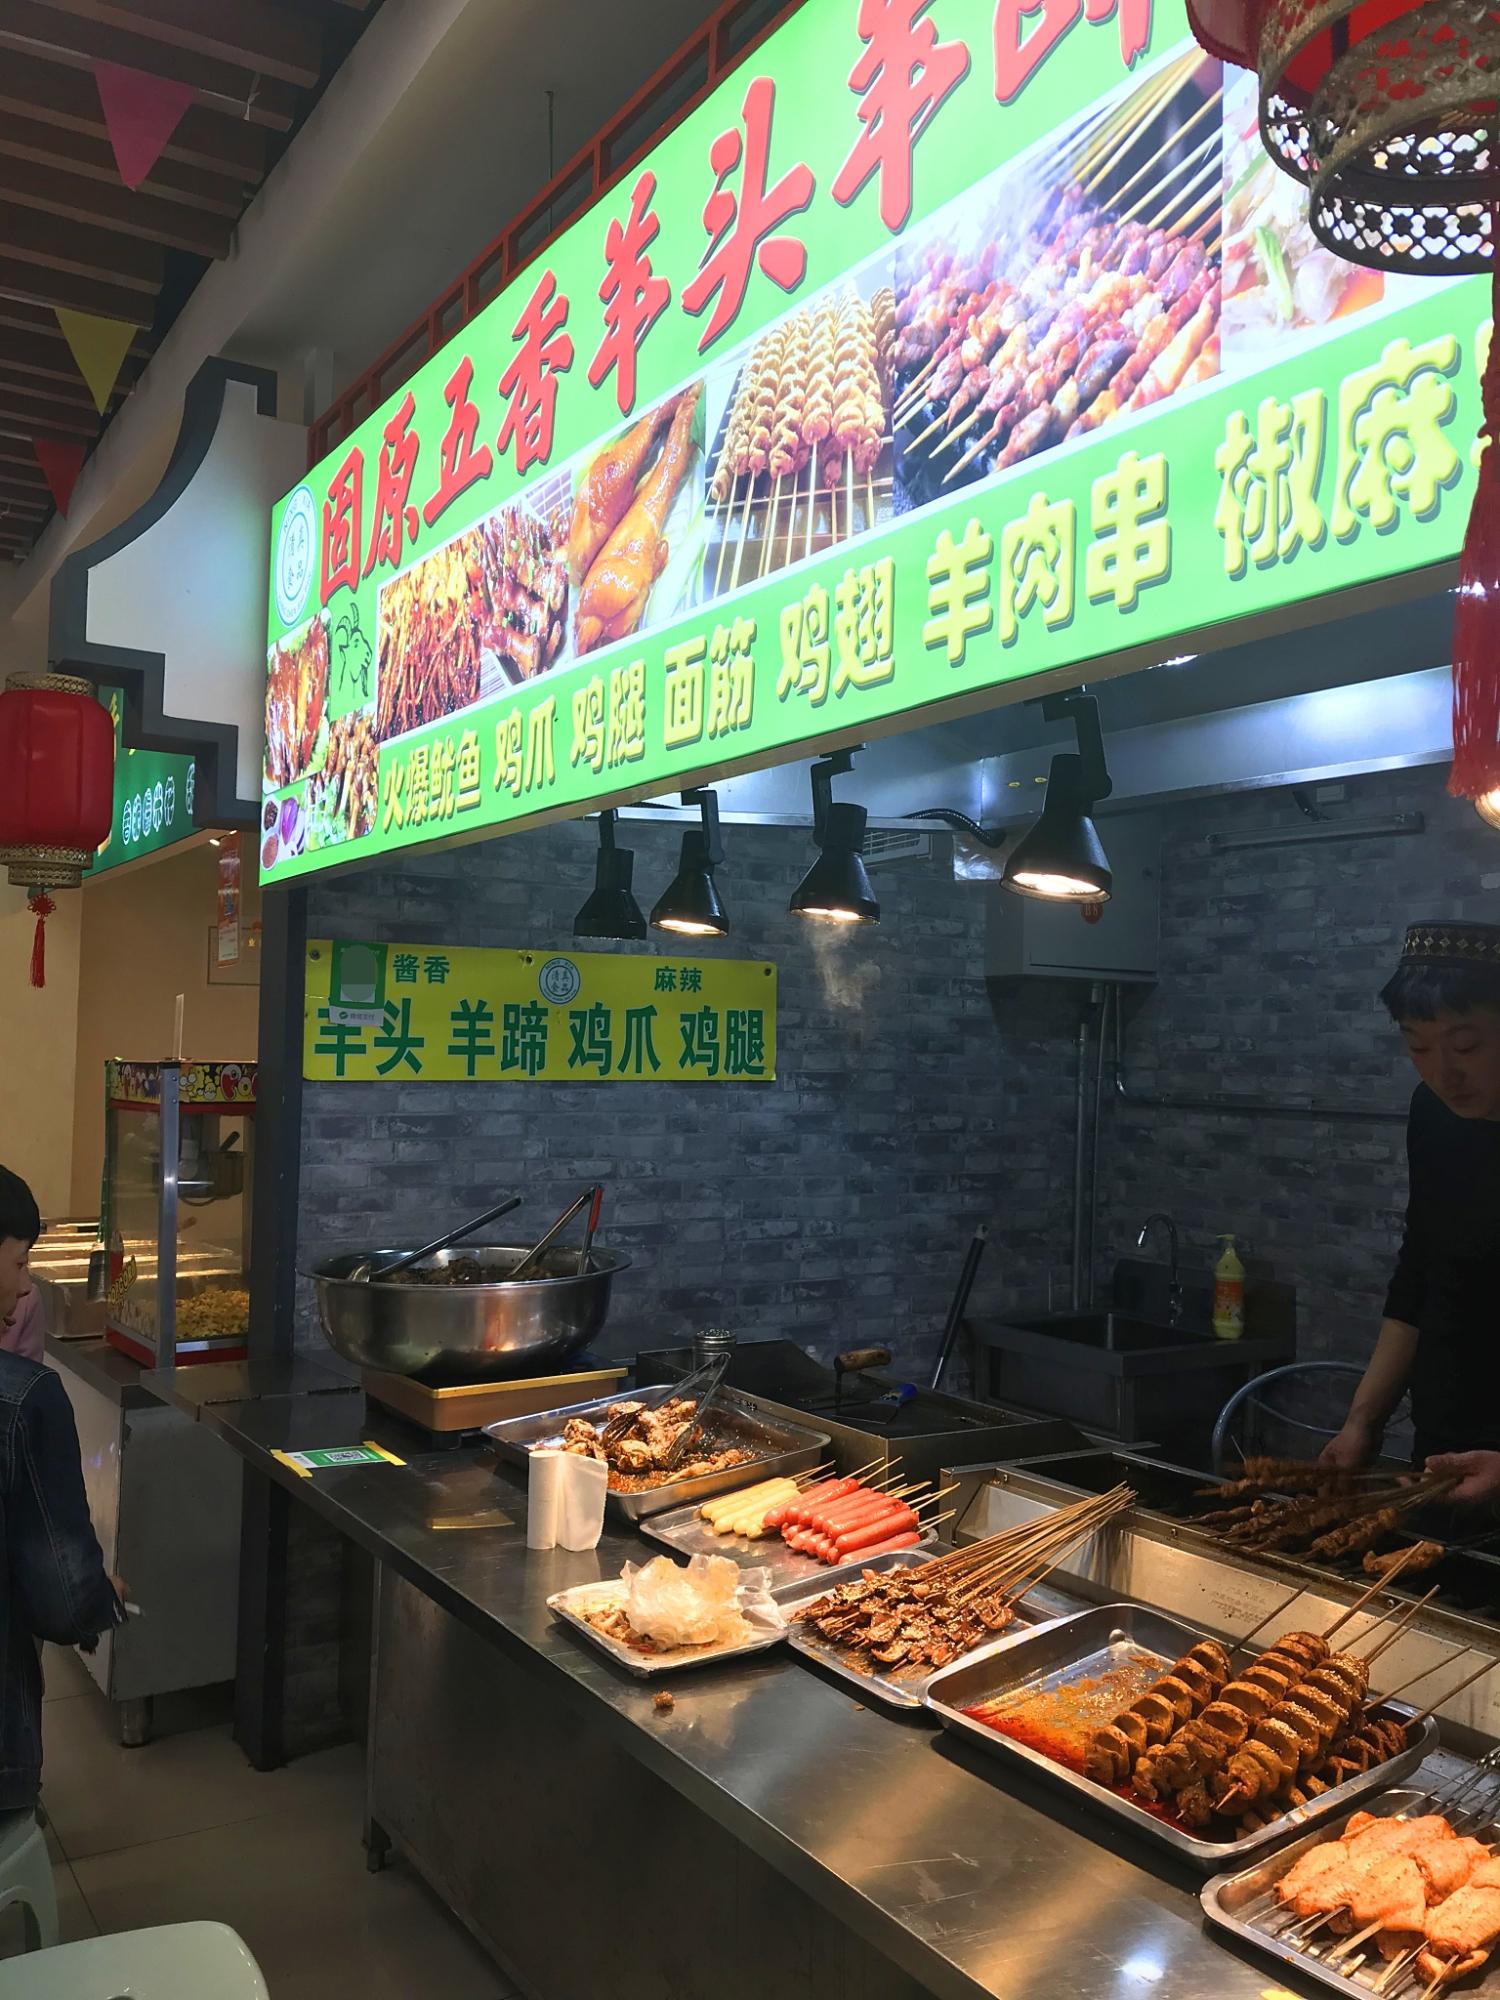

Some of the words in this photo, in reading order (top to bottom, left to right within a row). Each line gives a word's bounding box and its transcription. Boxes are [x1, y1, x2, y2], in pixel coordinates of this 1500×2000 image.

[384, 729, 481, 833] 火爆鱿鱼
[494, 695, 556, 797] 鸡爪
[570, 658, 646, 773] 鸡腿
[663, 616, 756, 751] 面筋
[777, 556, 896, 705] 鸡翅
[922, 451, 1171, 666] 羊肉串
[1213, 317, 1493, 580] 椒麻
[393, 954, 450, 984] 酱香
[654, 966, 702, 992] 麻辣
[448, 999, 548, 1076] 羊蹄
[568, 1002, 661, 1076] 鸡爪
[679, 1005, 766, 1075] 鸡腿
